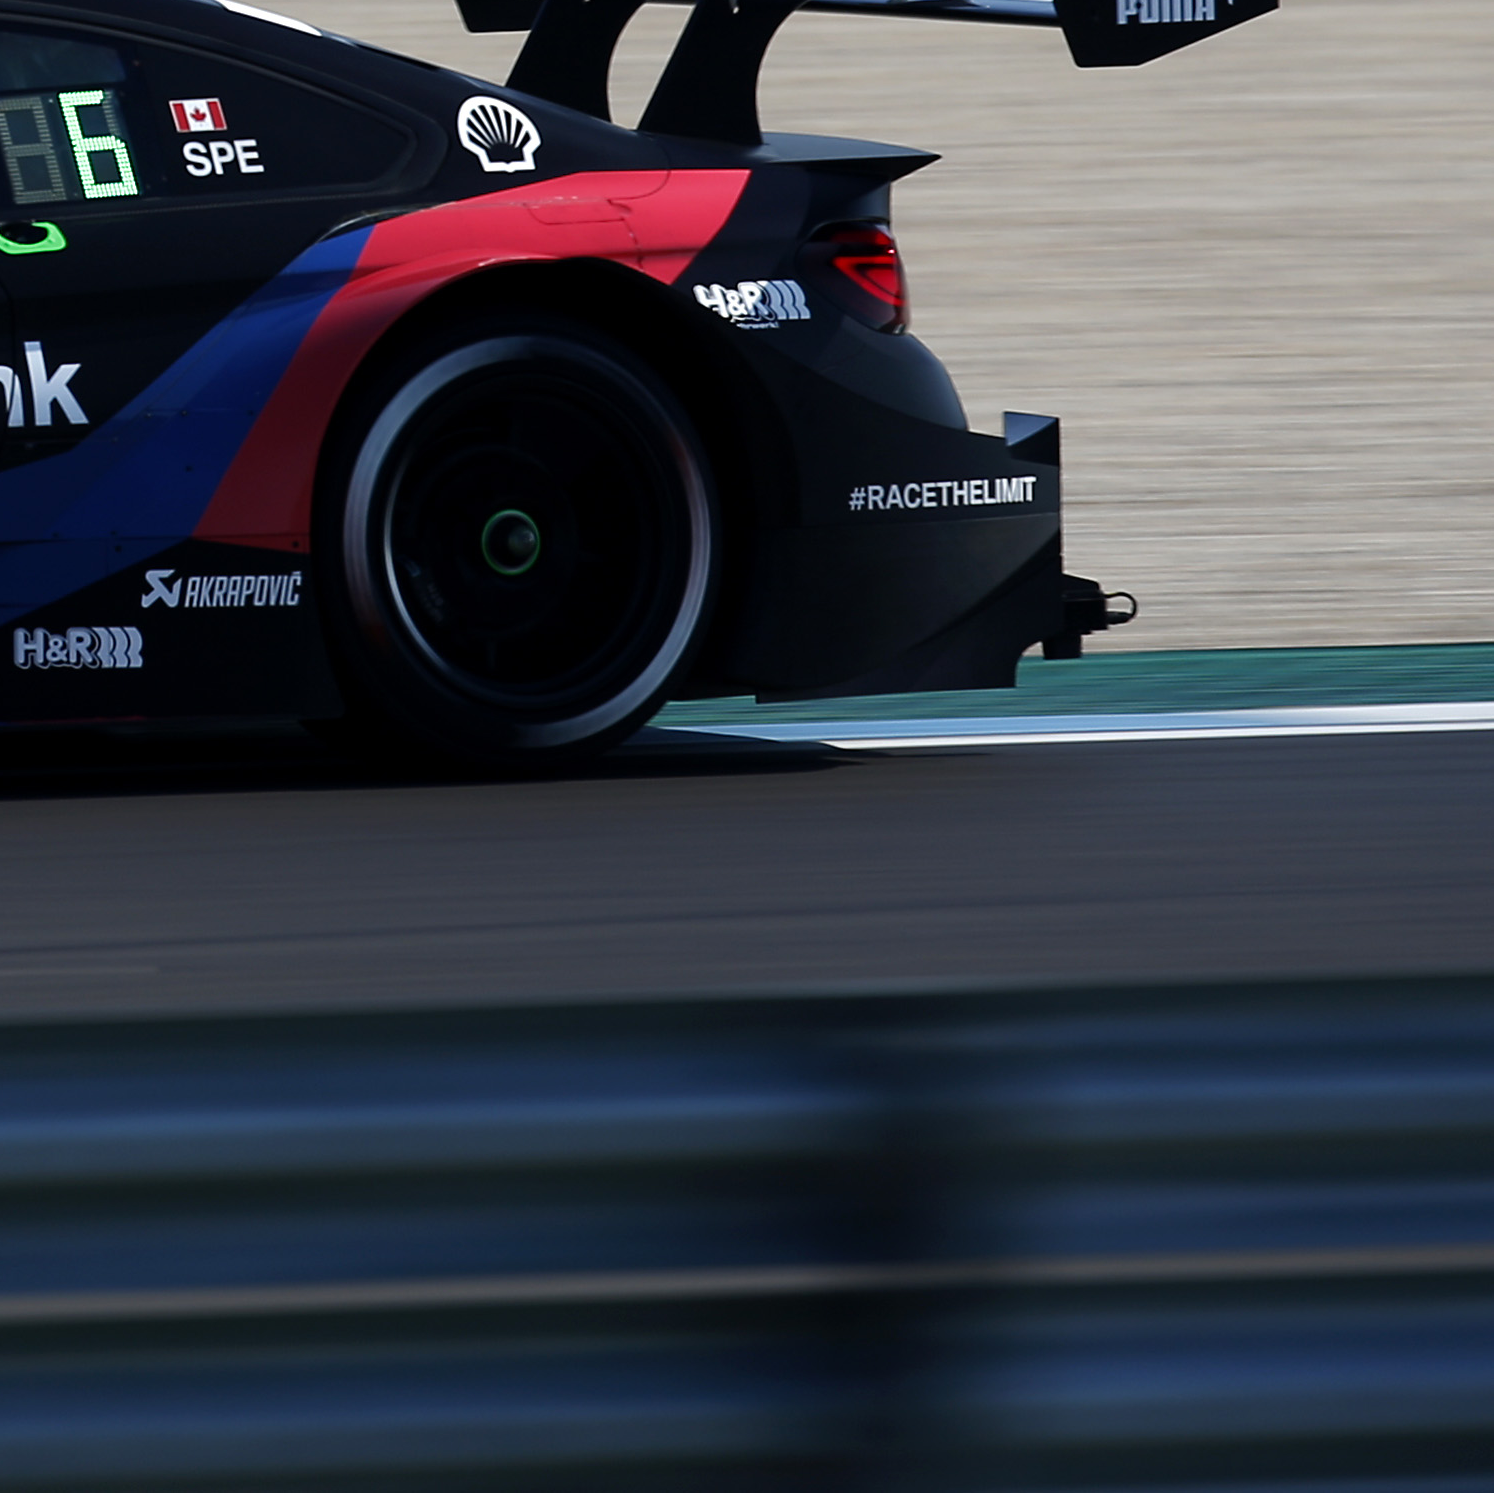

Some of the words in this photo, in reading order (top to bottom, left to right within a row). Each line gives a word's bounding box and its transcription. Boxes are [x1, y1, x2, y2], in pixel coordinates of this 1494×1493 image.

[59, 90, 138, 199] 6
[183, 139, 265, 177] SPE
[848, 475, 1038, 511] #RACETHELIMIT
[13, 626, 101, 670] H&R
